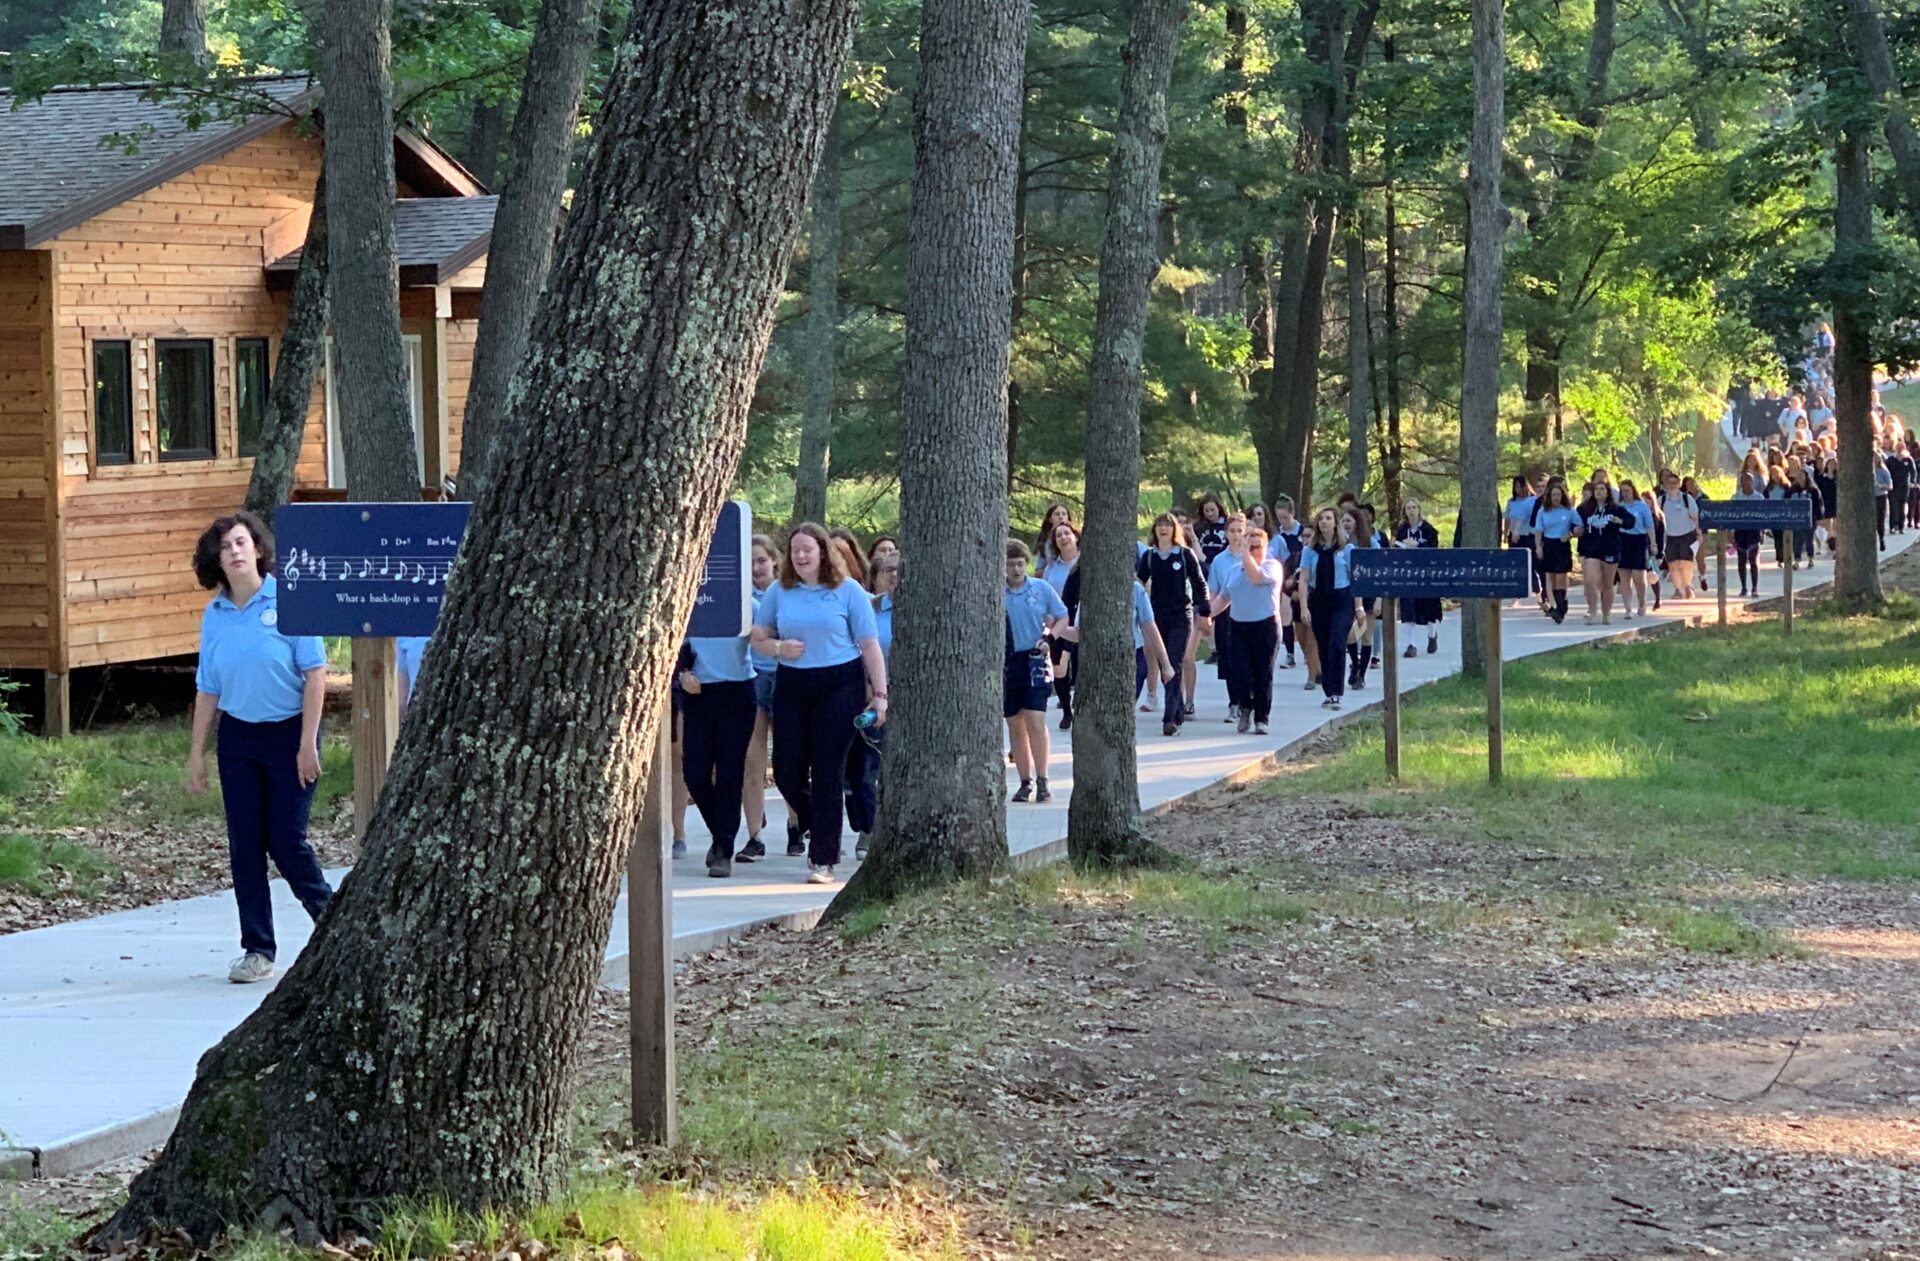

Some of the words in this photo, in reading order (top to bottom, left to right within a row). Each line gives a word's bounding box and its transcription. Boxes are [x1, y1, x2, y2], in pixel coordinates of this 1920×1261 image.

[381, 538, 388, 546] D
[336, 593, 359, 603] What
[369, 593, 411, 605] back-drop
[413, 593, 420, 603] is
